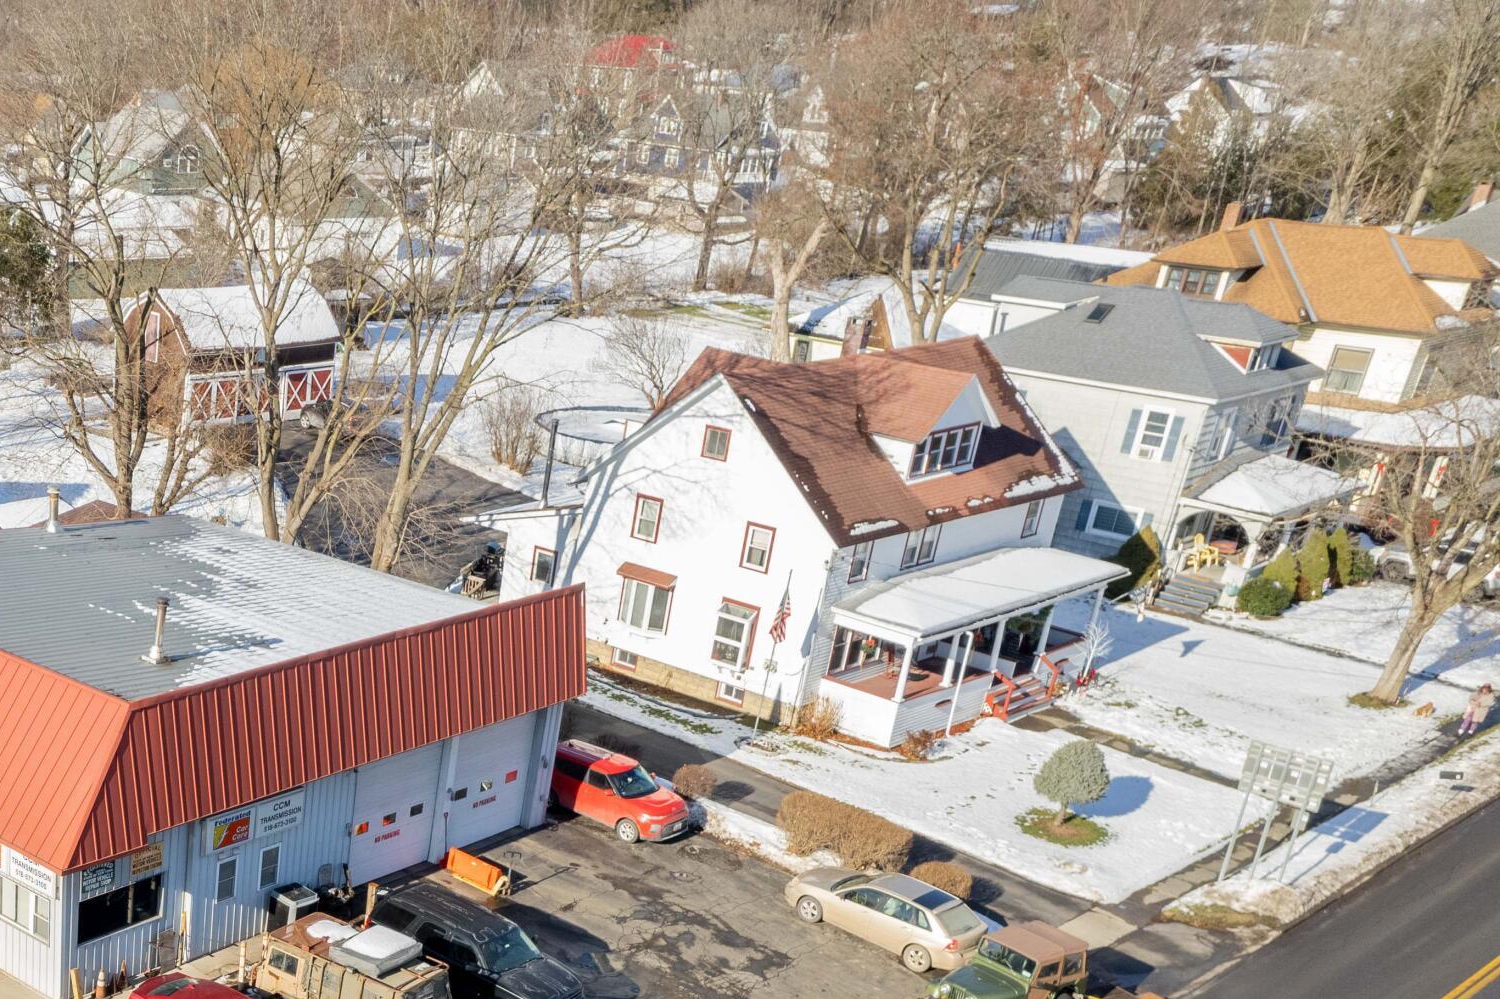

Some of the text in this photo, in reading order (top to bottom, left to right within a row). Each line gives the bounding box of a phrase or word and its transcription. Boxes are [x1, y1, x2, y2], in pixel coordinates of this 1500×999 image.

[273, 800, 291, 811] CCM
[215, 810, 251, 826] Federated
[260, 806, 302, 825] TRANSMISSION
[236, 825, 249, 833] Car
[12, 856, 52, 882] TRANSMISSION
